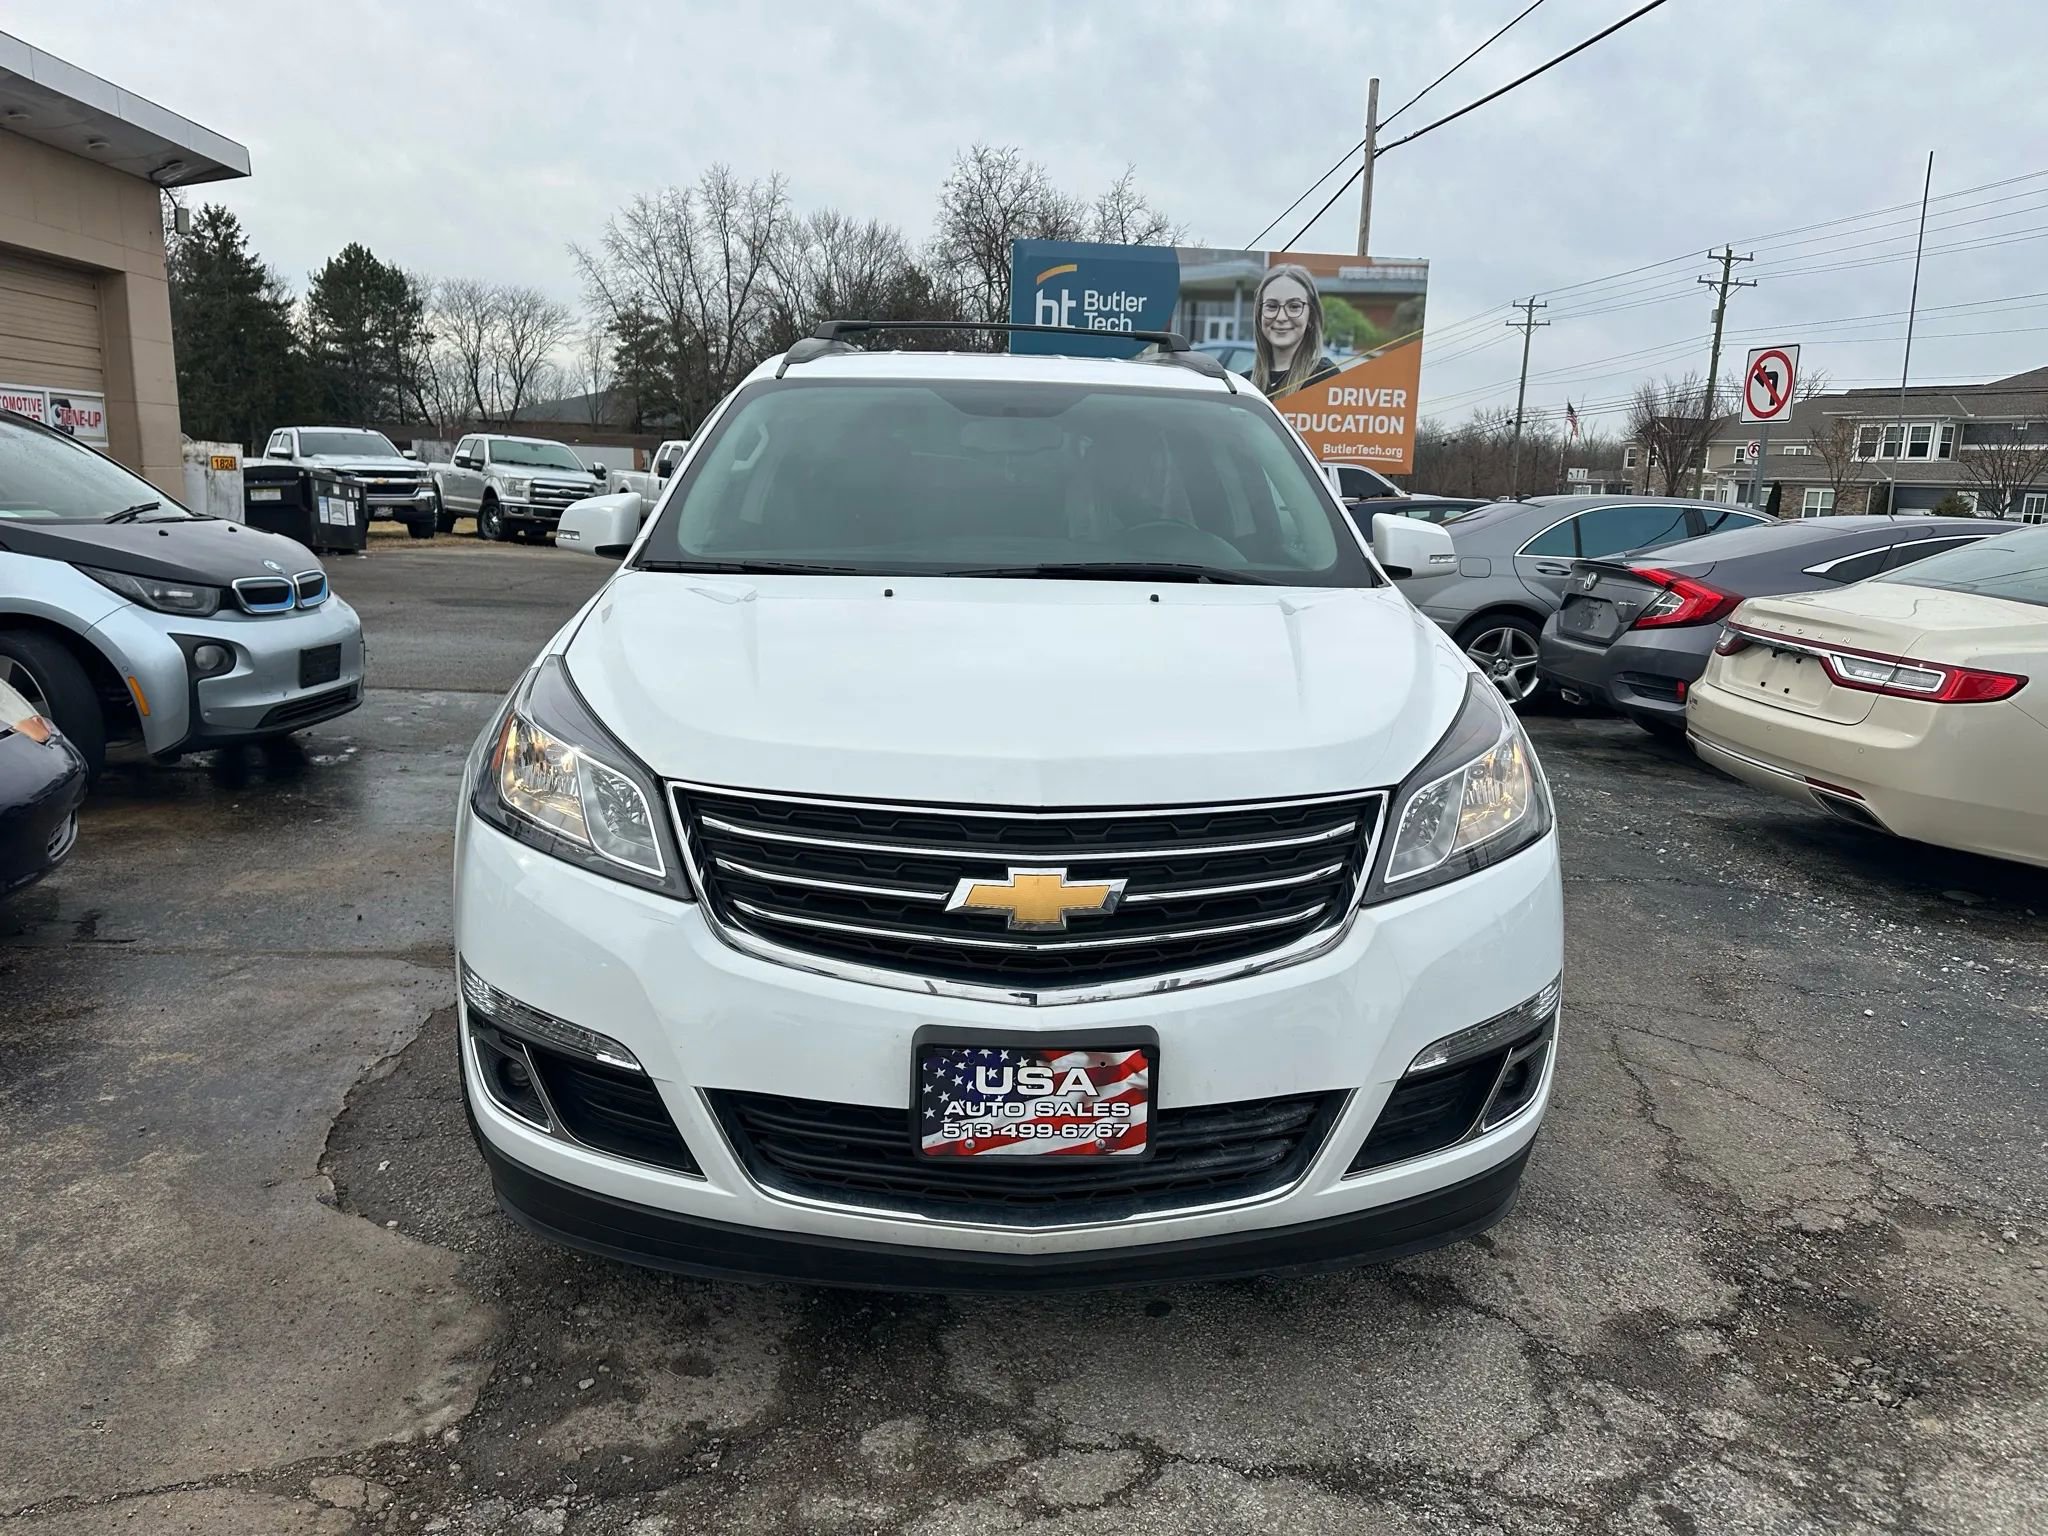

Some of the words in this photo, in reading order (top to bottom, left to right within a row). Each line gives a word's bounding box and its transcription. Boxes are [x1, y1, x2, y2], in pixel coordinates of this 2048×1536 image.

[1083, 289, 1147, 312] Butler
[1083, 312, 1132, 332] Tech
[0, 395, 43, 412] OMOTIVE
[1327, 387, 1407, 408] DRIVER
[59, 408, 102, 427] TUNE-UP
[1283, 412, 1405, 435] EDUCATION
[1323, 443, 1403, 458] ButlerTech.org
[975, 1066, 1098, 1096] USA
[943, 1101, 1025, 1117] AUTO
[1035, 1102, 1130, 1117] SALES
[943, 1123, 1131, 1138] 513-499-6767
